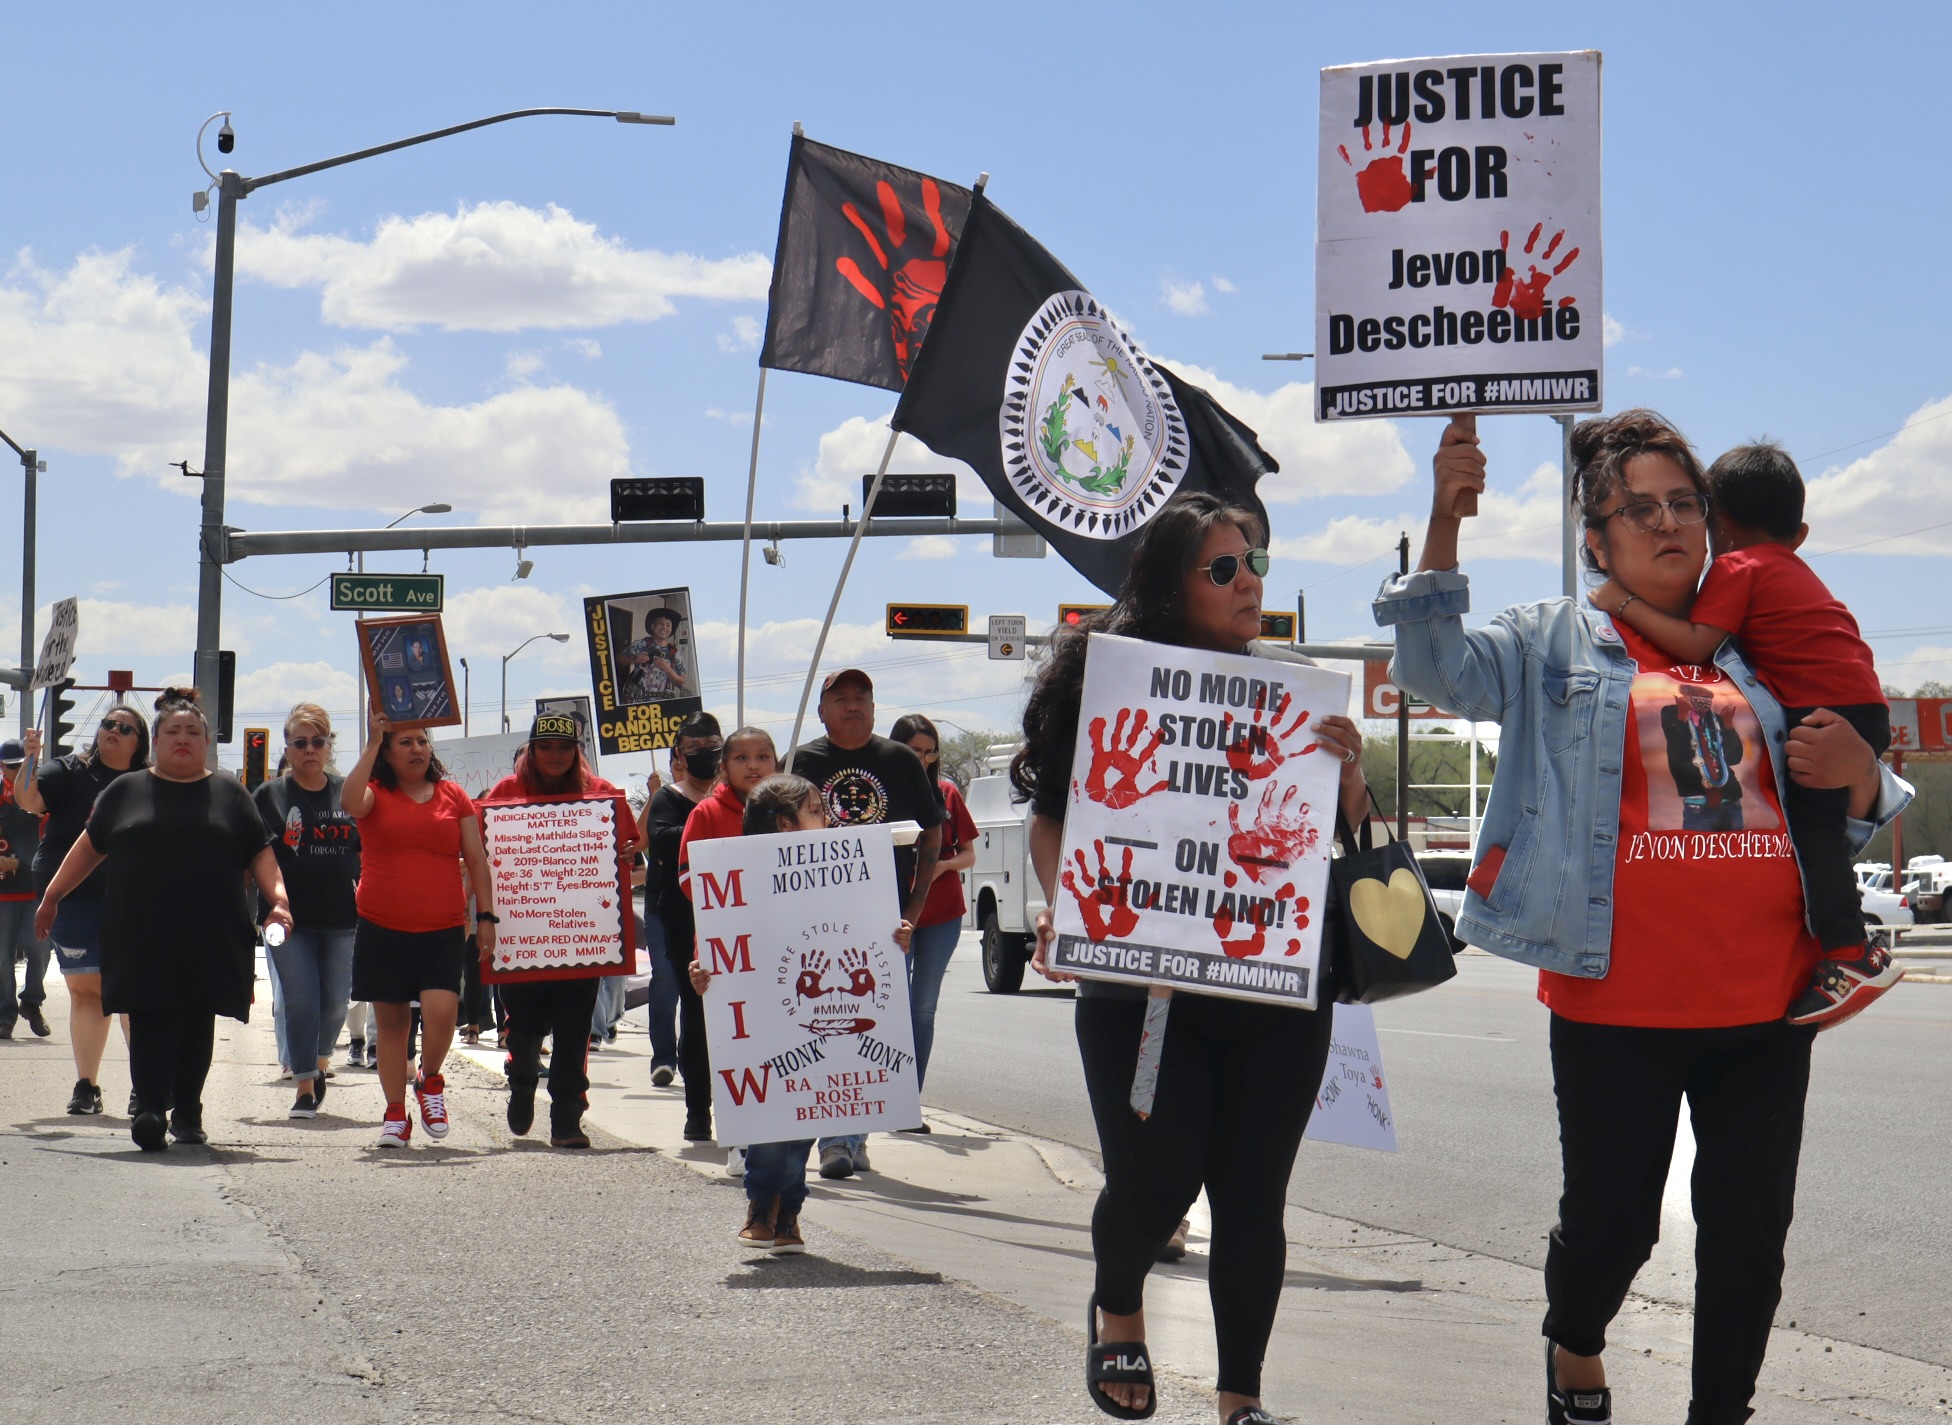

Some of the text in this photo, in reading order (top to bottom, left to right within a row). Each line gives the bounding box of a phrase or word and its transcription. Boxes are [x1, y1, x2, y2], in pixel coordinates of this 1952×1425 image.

[1354, 63, 1565, 128] JUSTICE
[1411, 145, 1508, 203] FOR
[1388, 247, 1507, 291] Jevon
[1091, 334, 1105, 345] OF
[1106, 338, 1125, 359] THE
[1328, 377, 1590, 413] JUSTICE FOR #MMIWR
[339, 582, 435, 603] Scott Ave
[592, 604, 615, 711] JUSTICE
[1150, 666, 1284, 711] NO MORE
[627, 703, 662, 721] FOR
[538, 719, 573, 734] BO$$
[600, 715, 688, 738] CANDRIC
[1158, 713, 1268, 756] STOLEN
[618, 731, 678, 752] BEGAY
[1167, 760, 1249, 800] LIVES
[493, 808, 593, 822] INDIGENOUS LIVES
[527, 818, 578, 829] MATTERS
[494, 829, 609, 844] Missing: Mathilda Silago
[1625, 831, 1689, 864] JEVON
[542, 843, 581, 854] Contact
[580, 855, 599, 865] NM
[777, 838, 865, 868] MELISSA
[1175, 838, 1220, 876] ON
[497, 870, 518, 881] Age:
[519, 869, 533, 878] 36
[772, 861, 871, 894] MONTOYA
[1096, 875, 1199, 916] STOLEN
[509, 908, 587, 918] No More Stolen
[1205, 889, 1287, 929] LAND!
[548, 920, 596, 929] Relatives
[499, 935, 516, 945] WE
[519, 935, 550, 945] WEAR
[551, 935, 571, 944] RED
[572, 934, 588, 943] ON
[516, 946, 607, 959] FOR OUR MMIR
[777, 945, 796, 985] MORE
[802, 922, 850, 940] STOLE
[868, 941, 891, 1011] SISTERS
[1066, 942, 1300, 992] JUSTICE FOR #MMIWR
[813, 1003, 860, 1015] #MMIW
[784, 1069, 890, 1093] RA NELLE
[1339, 1062, 1367, 1087] Toya
[815, 1087, 864, 1105] ROSE
[796, 1100, 886, 1121] BENNETT
[1102, 1354, 1148, 1371] FILA
